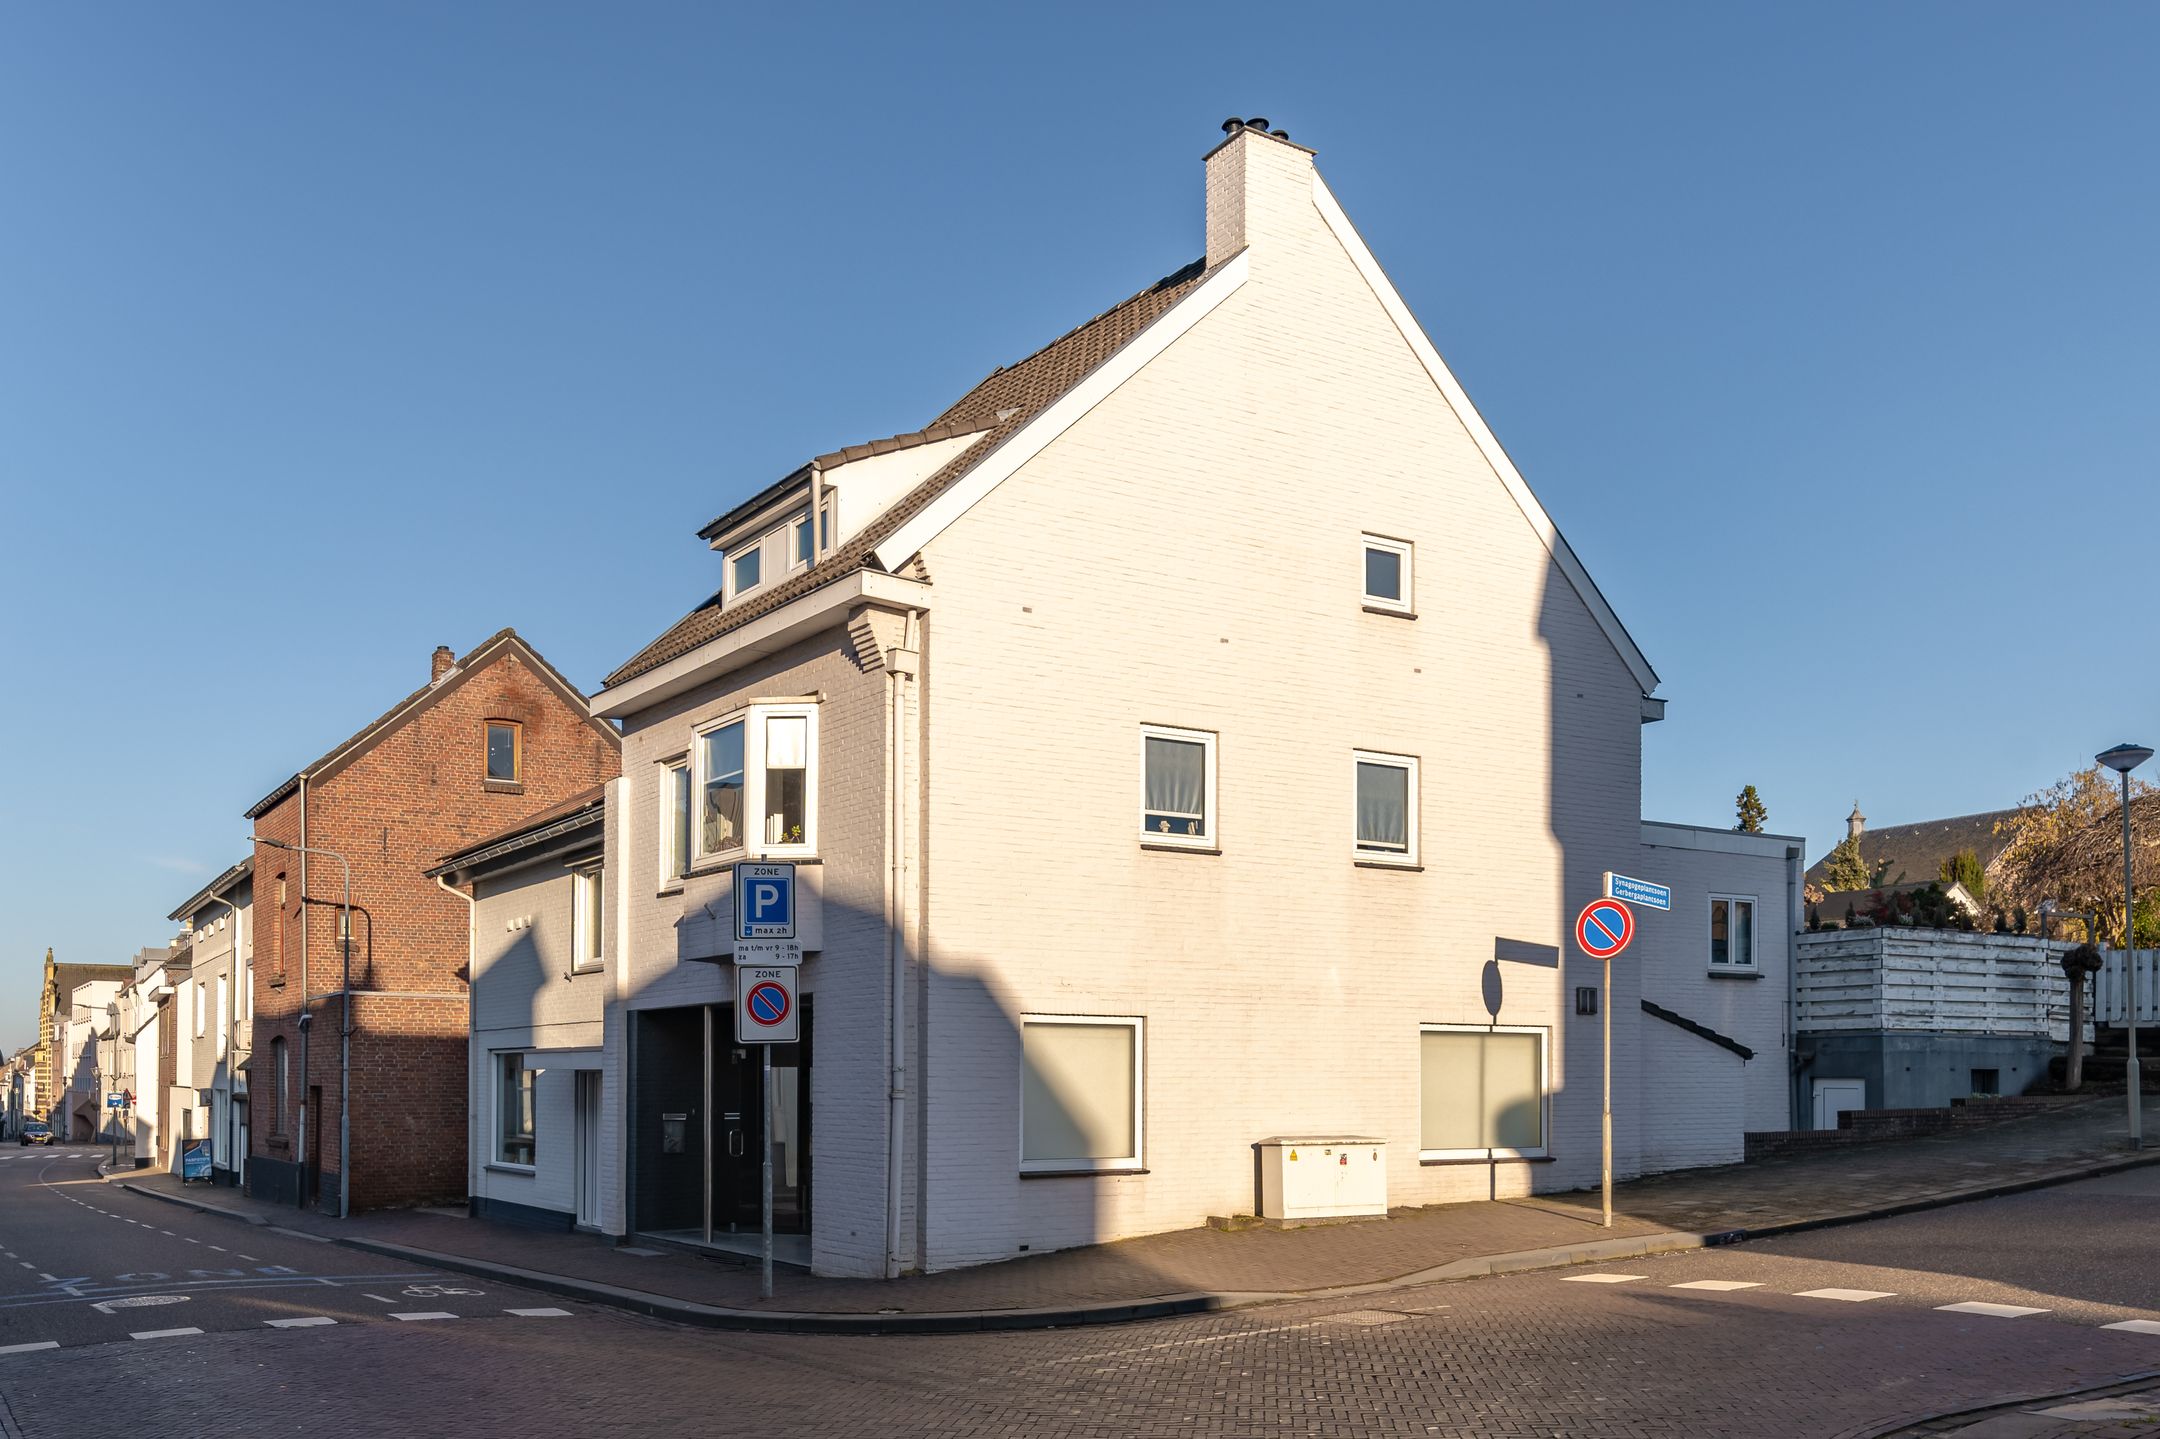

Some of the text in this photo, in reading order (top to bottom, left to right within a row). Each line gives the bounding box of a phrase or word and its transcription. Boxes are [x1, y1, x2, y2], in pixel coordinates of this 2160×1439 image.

[754, 868, 780, 876] ZONE
[755, 884, 779, 919] P
[755, 970, 781, 978] ZONE
